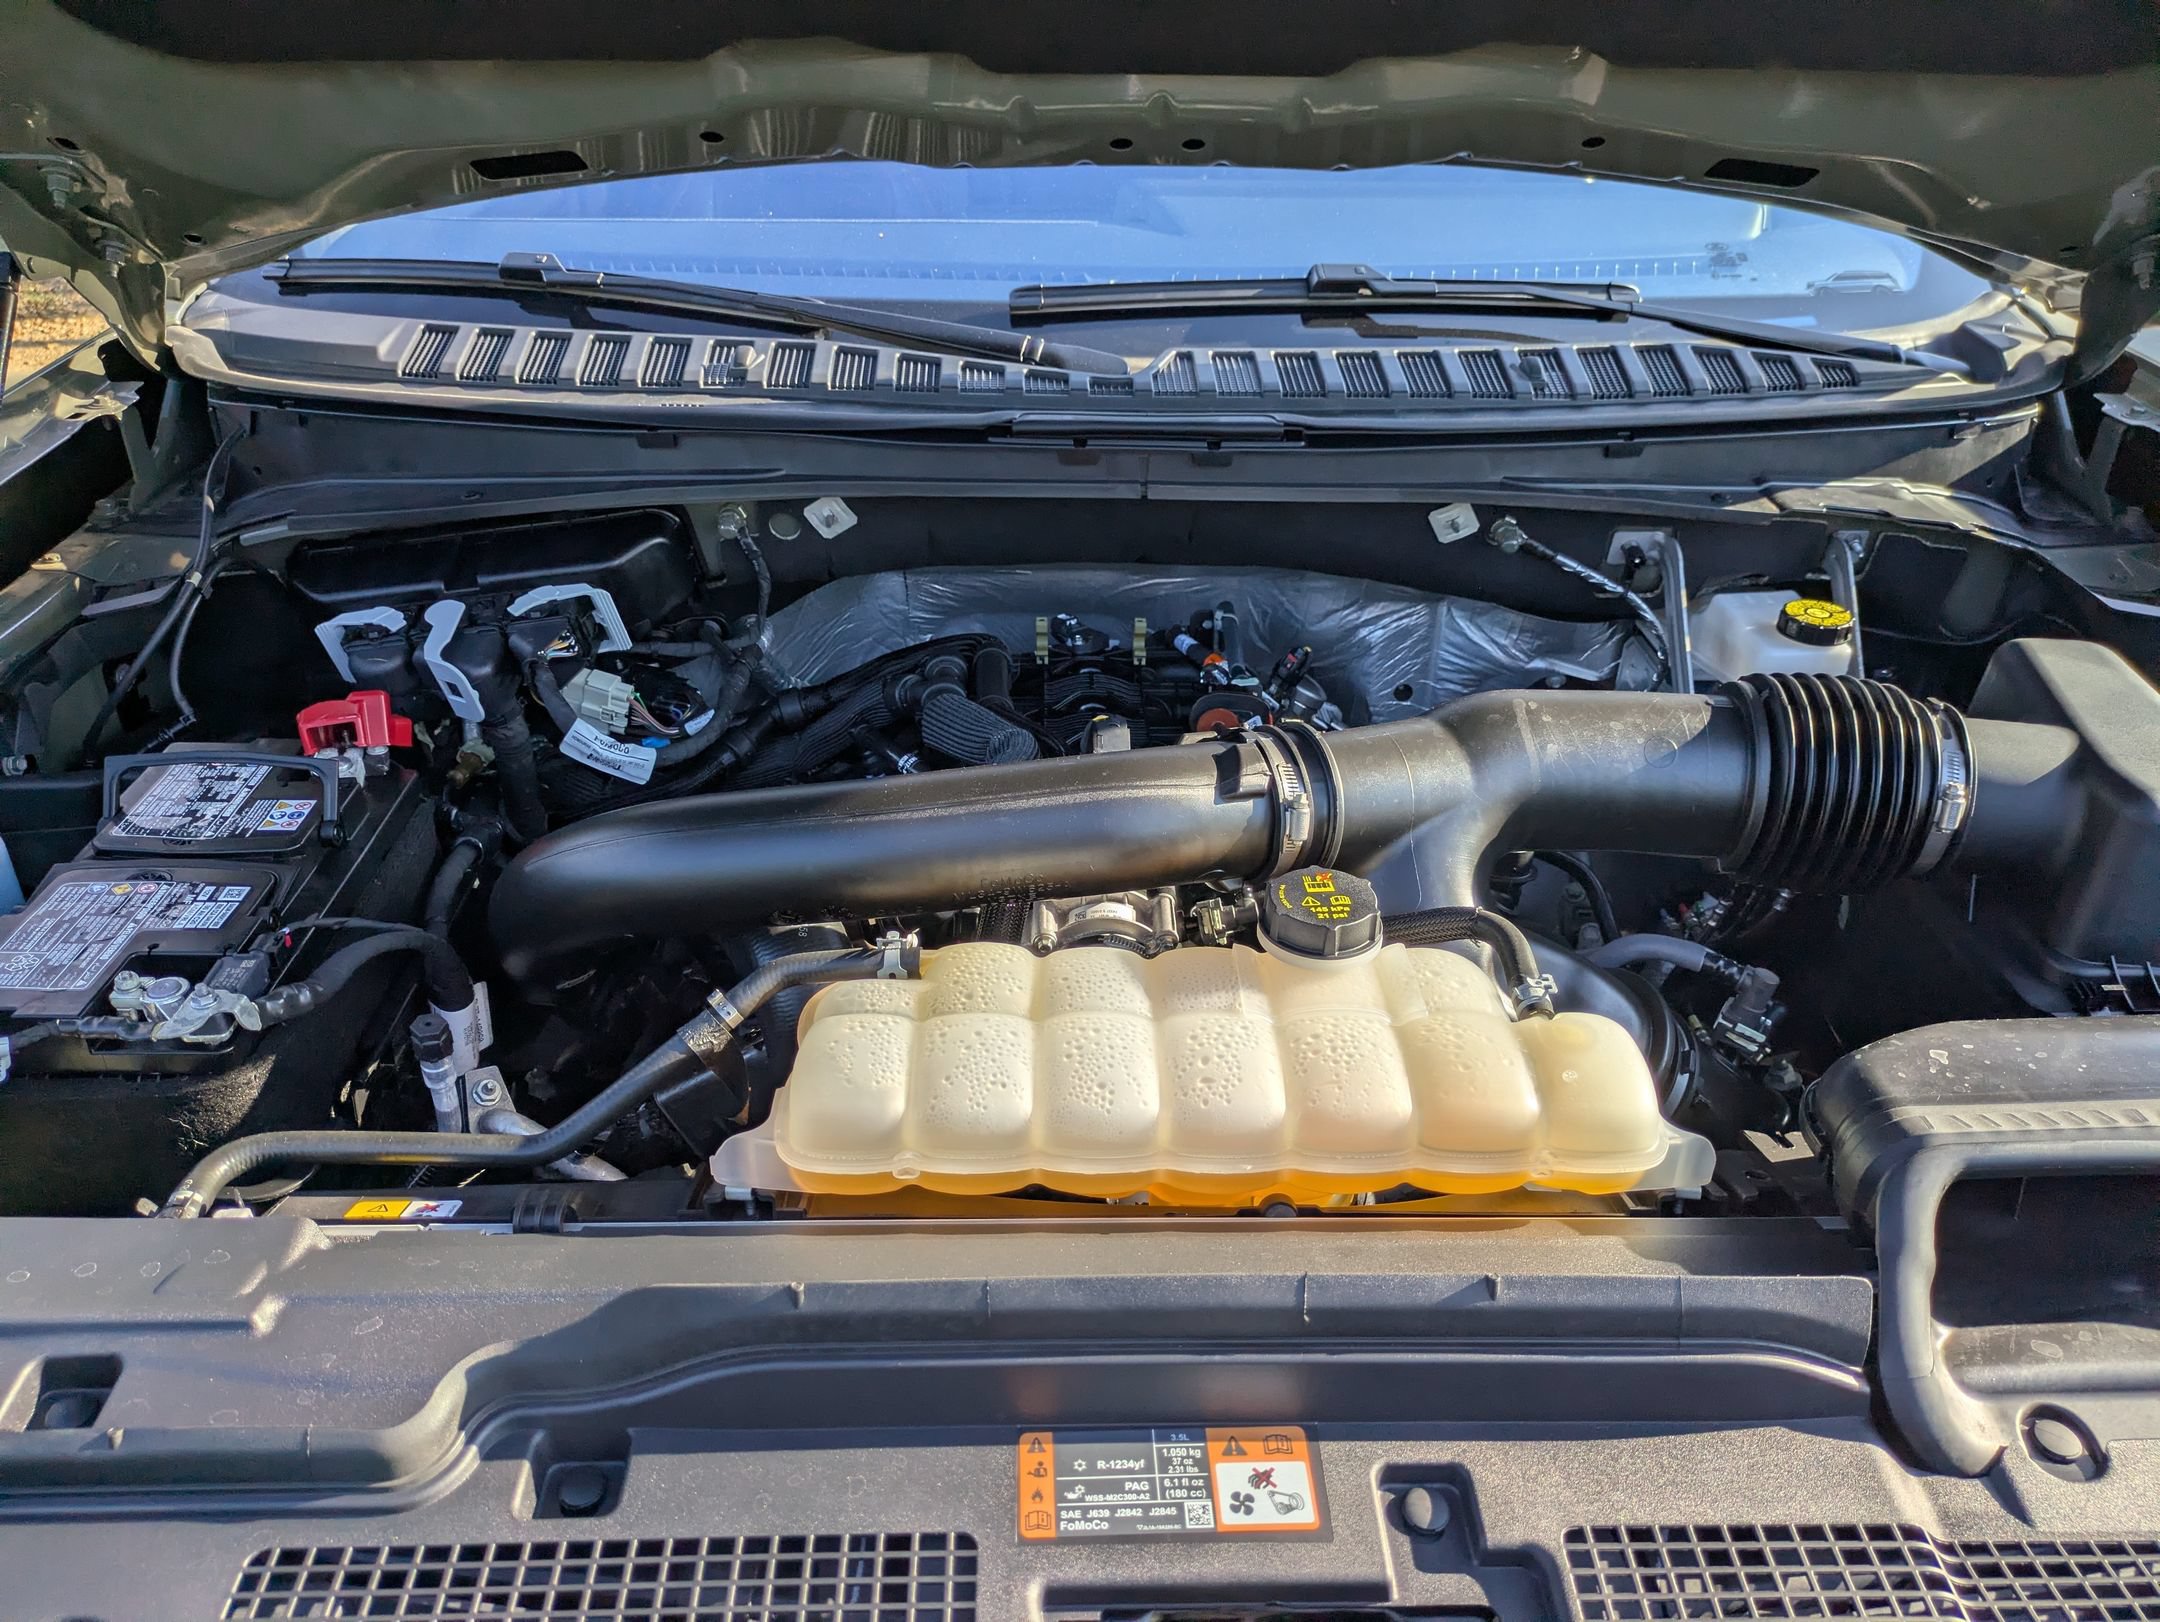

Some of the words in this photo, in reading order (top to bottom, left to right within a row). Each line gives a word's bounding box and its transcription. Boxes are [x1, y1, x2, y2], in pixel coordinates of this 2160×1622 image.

[1162, 1448, 1187, 1456] 1.050
[1188, 1448, 1201, 1458] kg
[1097, 1459, 1145, 1470] R-1234yf
[1124, 1482, 1149, 1491] PAG
[1164, 1478, 1178, 1486] 6.1
[1181, 1478, 1189, 1486] fl
[1166, 1490, 1187, 1499] (180
[1190, 1489, 1206, 1498] cc)
[1060, 1510, 1082, 1519] SAE
[1086, 1510, 1110, 1518] J639
[1114, 1508, 1142, 1517] J2842
[1149, 1507, 1177, 1516] J2845
[1060, 1521, 1109, 1530] FoMoCo
